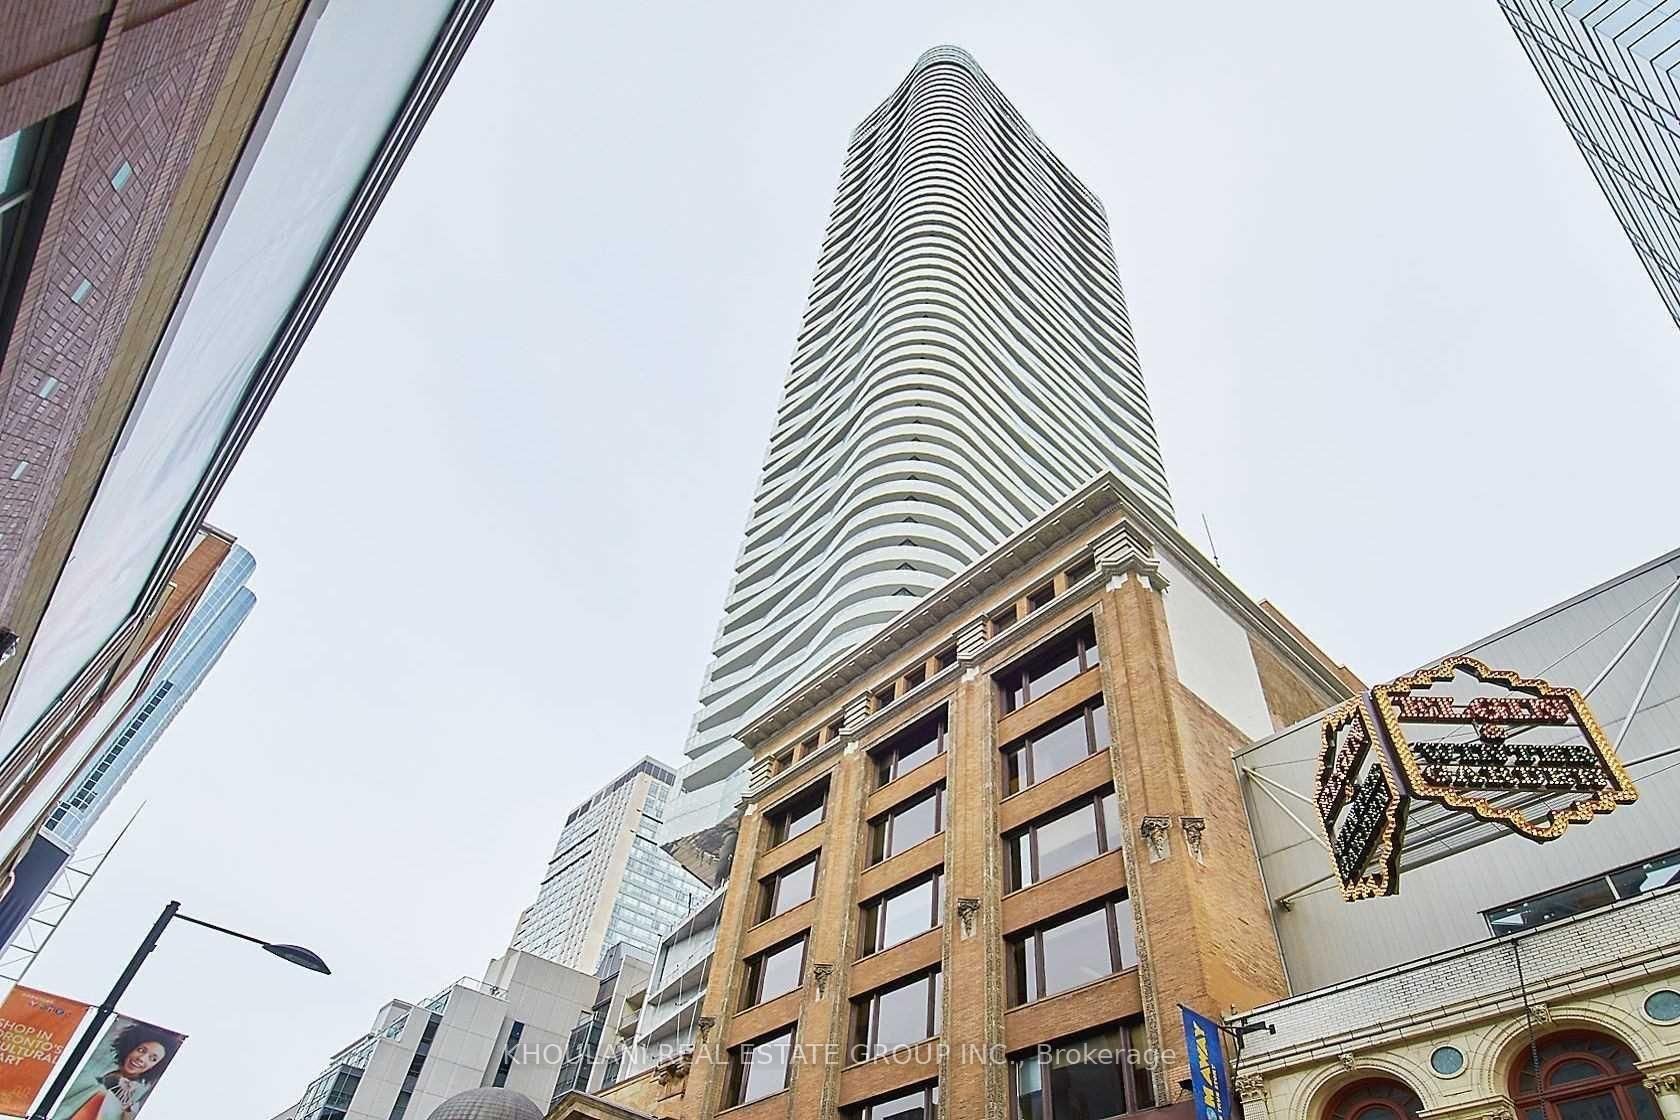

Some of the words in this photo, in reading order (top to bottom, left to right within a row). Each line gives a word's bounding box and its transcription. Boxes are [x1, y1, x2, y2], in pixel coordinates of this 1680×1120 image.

[1411, 742, 1599, 763] WINTER
[1424, 764, 1608, 786] GARDEN
[36, 1030, 53, 1041] IN
[1192, 1020, 1213, 1087] AWAY
